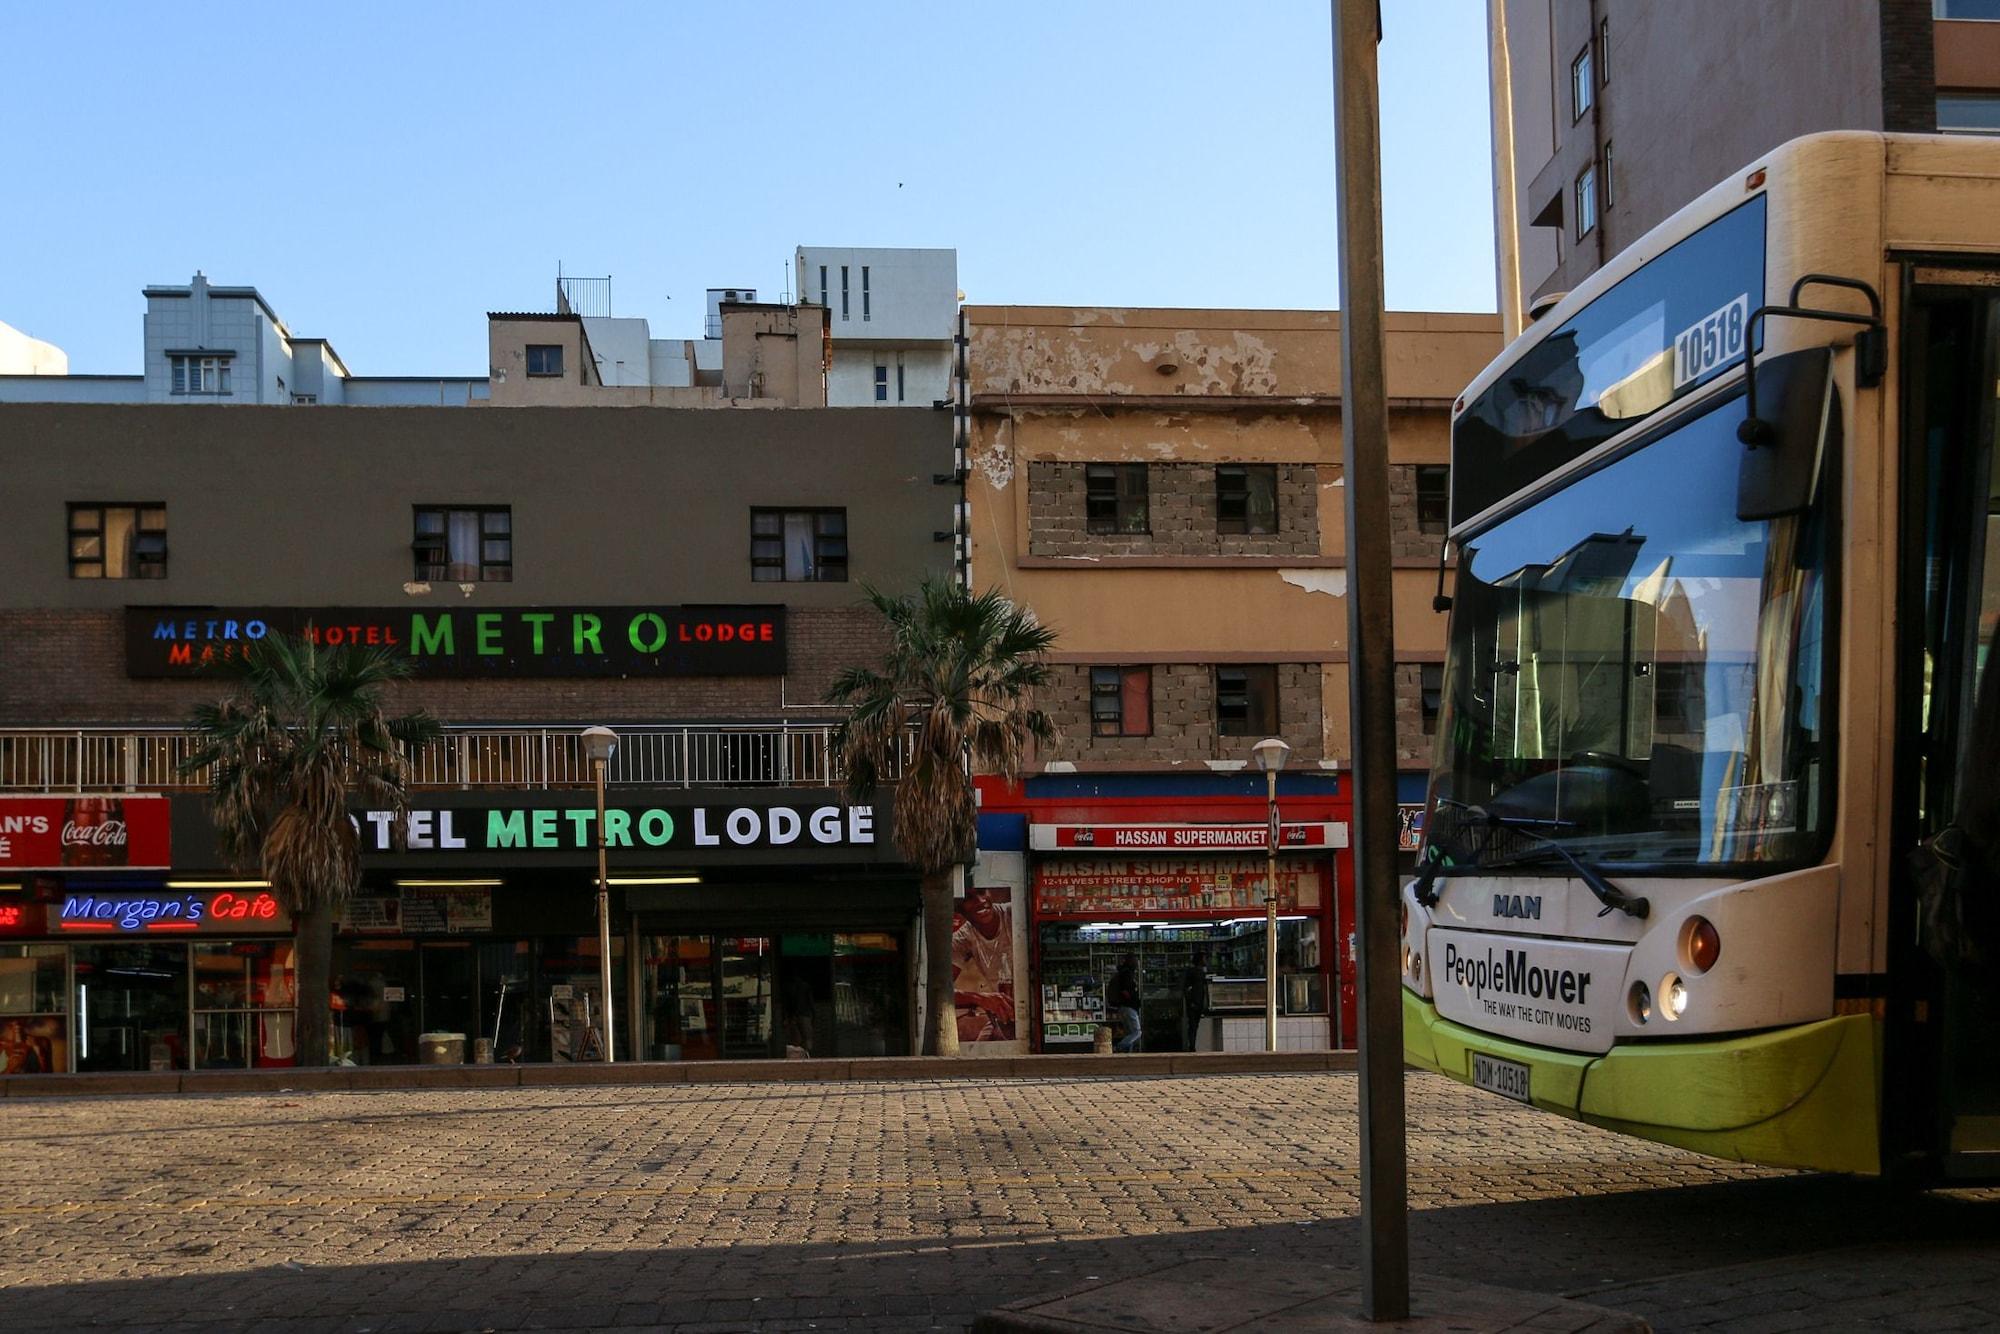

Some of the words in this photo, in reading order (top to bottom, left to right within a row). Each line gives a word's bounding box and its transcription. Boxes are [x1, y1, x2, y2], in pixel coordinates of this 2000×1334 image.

[1679, 302, 1742, 382] 10518
[153, 619, 267, 640] METRO
[305, 624, 400, 646] HOTEL
[409, 611, 669, 656] METRO
[679, 623, 775, 642] LODGE
[61, 819, 128, 846] Coca-Cola
[348, 809, 467, 850] TEL
[486, 808, 675, 849] METRO
[693, 805, 875, 846] LODGE
[1115, 830, 1167, 845] HASSAN
[1174, 829, 1268, 845] SUPERMARKET
[1041, 861, 1128, 877] HASAN
[1134, 859, 1316, 876] SUPERMARKET
[1071, 877, 1101, 885] WEST
[1103, 877, 1142, 885] STREET
[1145, 876, 1175, 884] SHOP
[1176, 876, 1193, 884] NO
[62, 895, 204, 929] Morgan's
[1493, 894, 1542, 919] MAN
[1446, 943, 1591, 1004] PeopleMover
[1484, 999, 1498, 1016] THE
[1499, 1002, 1516, 1018] WAY
[1518, 1005, 1534, 1022] THE
[1535, 1009, 1555, 1027] CITY
[1556, 1013, 1591, 1033] MOVES
[1475, 1057, 1493, 1087] NDM
